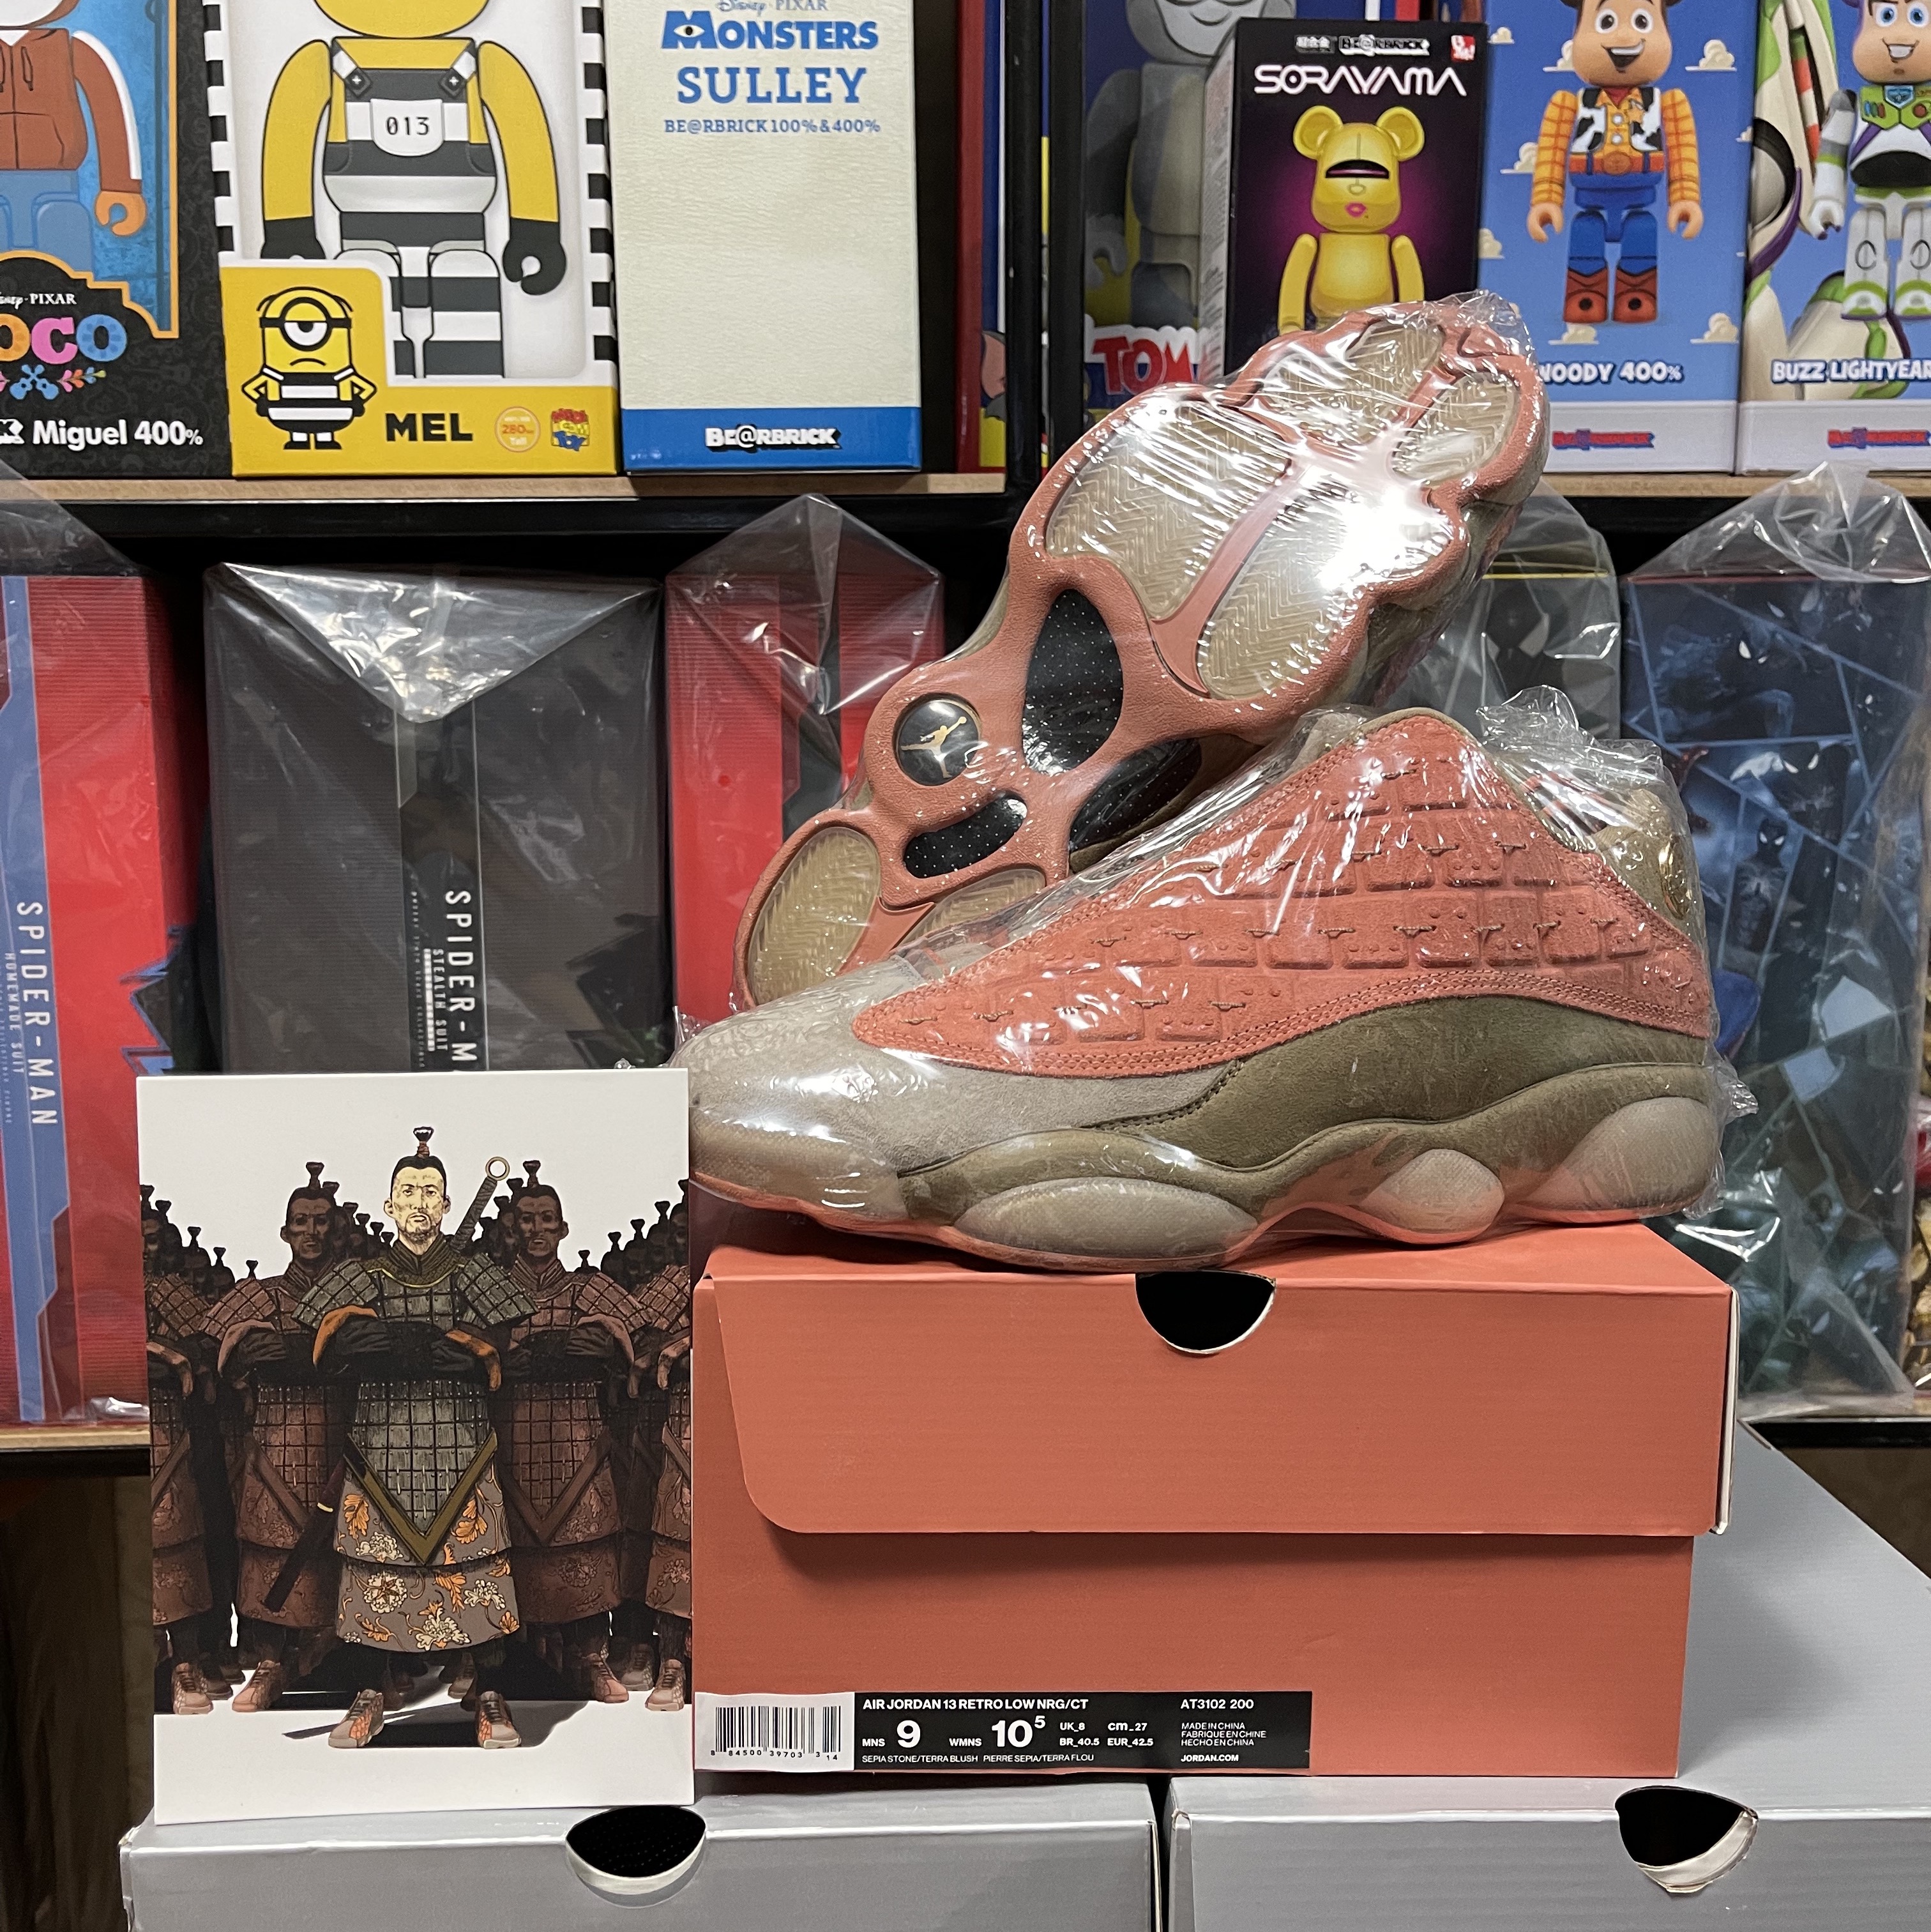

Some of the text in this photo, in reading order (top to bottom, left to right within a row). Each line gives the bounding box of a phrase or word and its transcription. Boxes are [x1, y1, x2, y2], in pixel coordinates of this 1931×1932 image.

[776, 0, 829, 11] PIXAR
[661, 10, 879, 50] MONSTERS
[677, 66, 867, 104] SULLEY
[1253, 64, 1467, 96] SORAYAMA
[386, 116, 429, 135] 013
[29, 293, 77, 305] PIXAR
[0, 314, 127, 365] OCO
[1093, 336, 1193, 395] TOM
[1619, 361, 1683, 382] 400%
[1771, 359, 1931, 382] BUZZ LIGHTYEAR
[32, 419, 128, 451] Miguel
[133, 420, 204, 445] 400%
[385, 413, 473, 442] MEL
[704, 424, 839, 450] BE@RBRICK
[445, 890, 478, 1061] SPIDER-M
[432, 948, 448, 1051] STEALTH SUIT
[17, 901, 59, 1124] SPIDER-MAN
[11, 1042, 25, 1074] SUIT
[863, 1699, 1089, 1710] AIR JORDAN 13 RETRO LOW NRG/CT
[1180, 1699, 1254, 1709] AT3102 200
[862, 1720, 921, 1748] MNS 9
[949, 1738, 982, 1747] WMNS
[1059, 1737, 1100, 1747] BR_40.5
[1107, 1737, 1154, 1748] EUR_42.5
[1181, 1730, 1225, 1738] FABRIQUE
[1239, 1730, 1267, 1738] CHINE
[769, 1750, 803, 1758] 39703
[983, 1754, 1013, 1763] PIERRE
[1013, 1754, 1070, 1763] SEPIA/TERRA
[1180, 1754, 1239, 1762] JORDAN.COM
